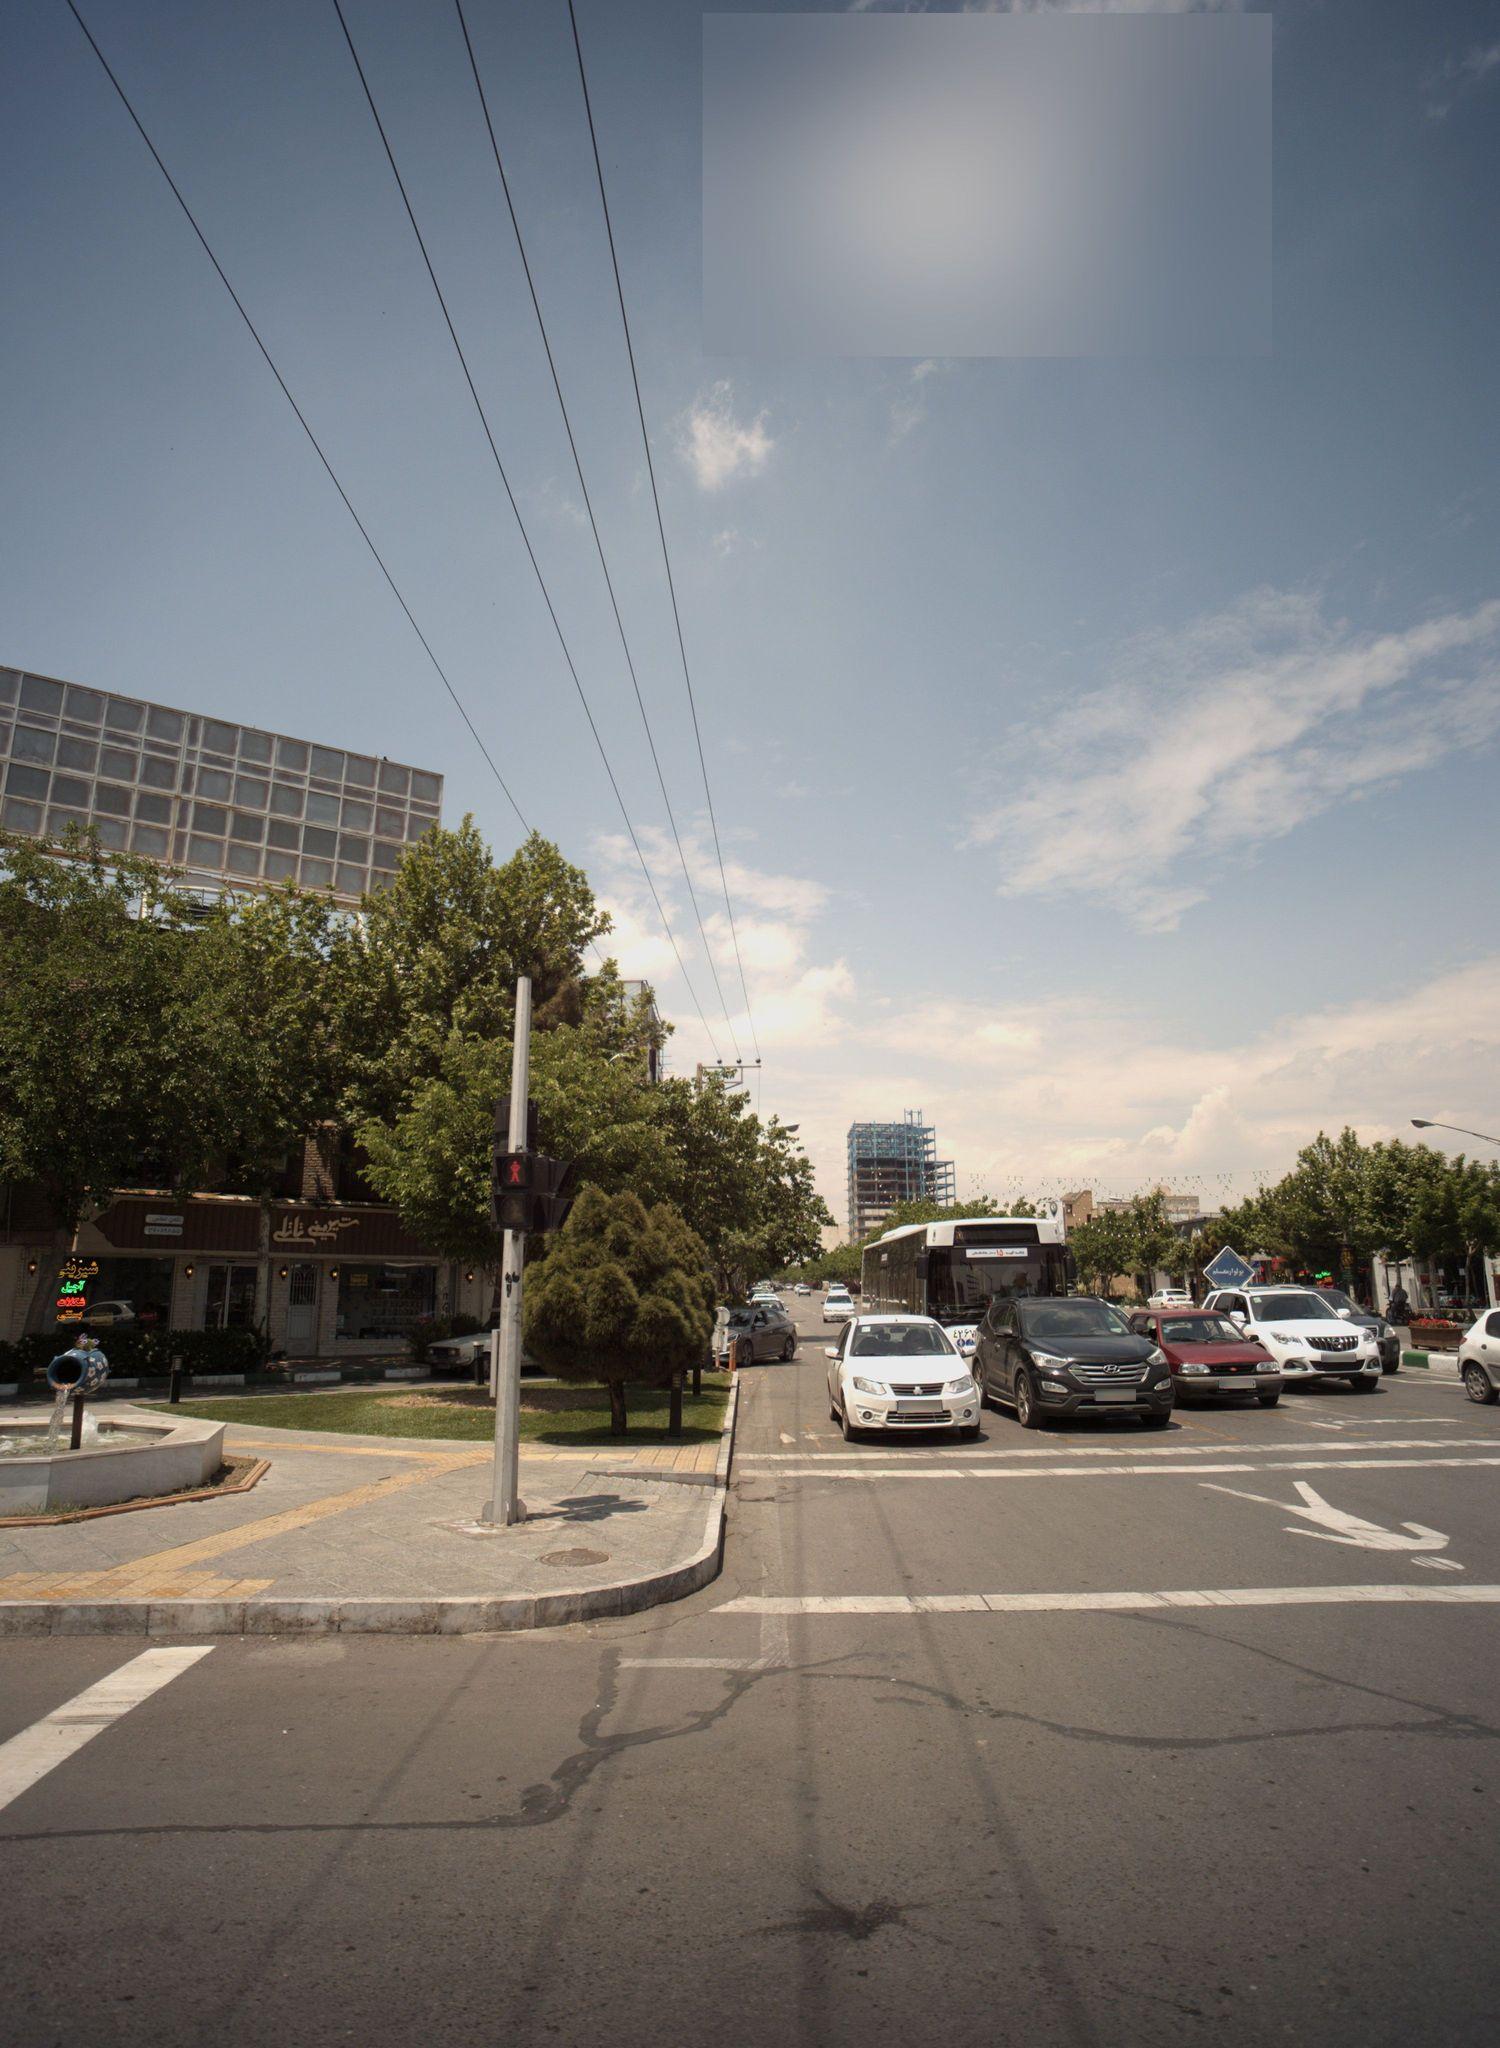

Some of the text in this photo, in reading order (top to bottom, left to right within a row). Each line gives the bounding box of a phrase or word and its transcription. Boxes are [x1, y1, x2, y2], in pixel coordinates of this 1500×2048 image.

[308, 1216, 360, 1241] شیرینی
[61, 1280, 86, 1294] آجیل
[57, 1296, 86, 1307] شکلات
[57, 1309, 83, 1321] بستنی
